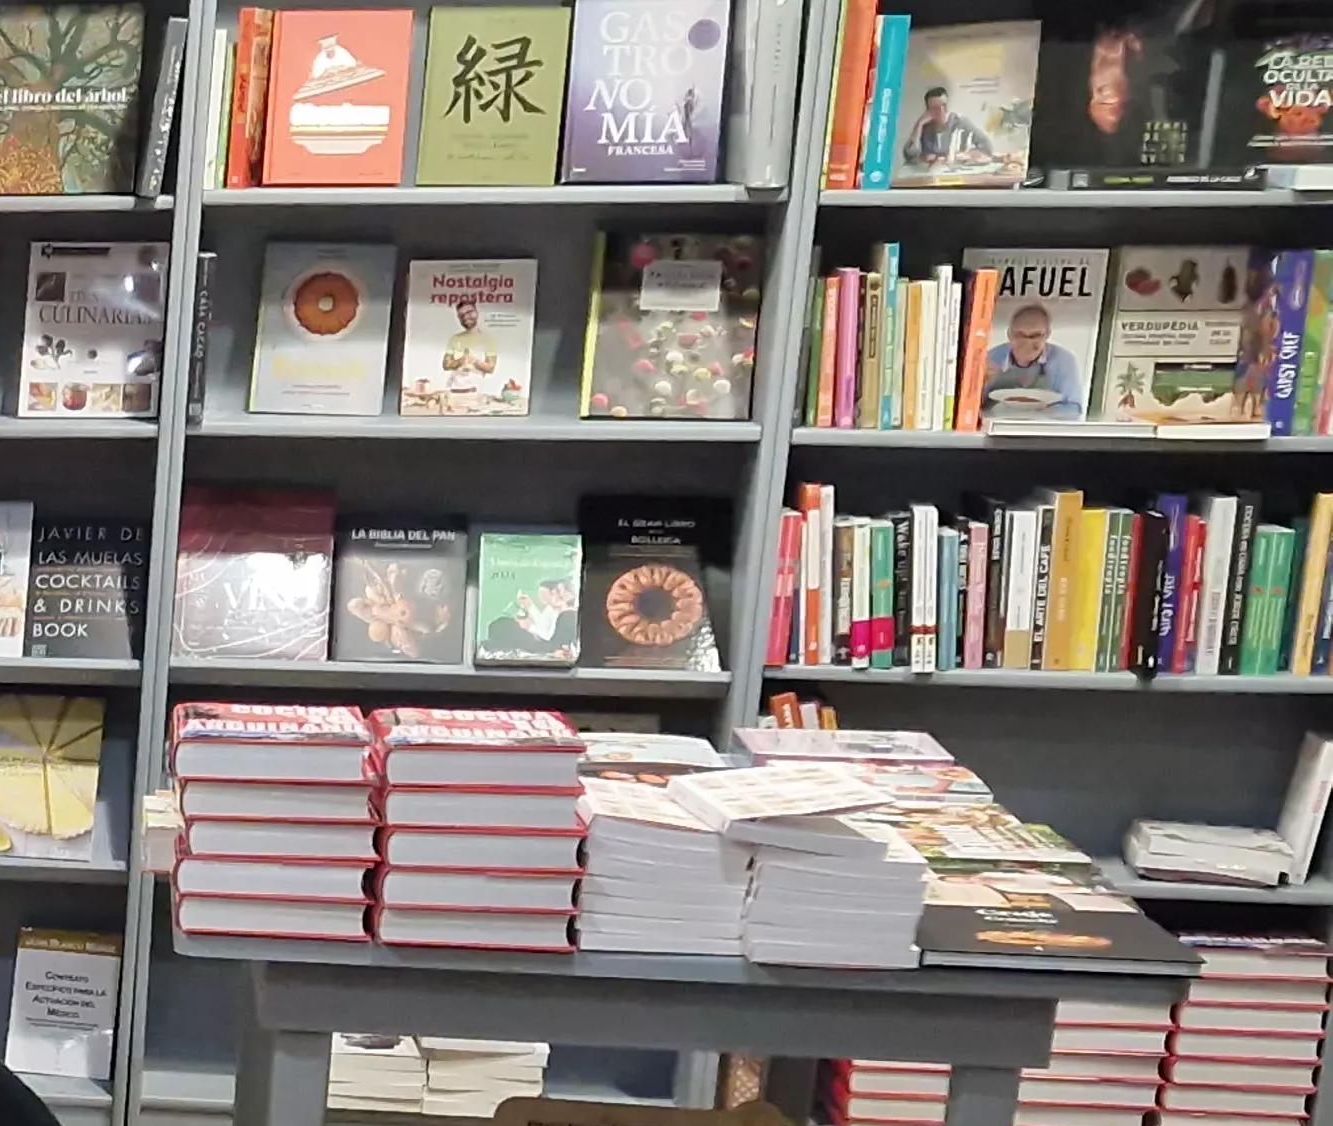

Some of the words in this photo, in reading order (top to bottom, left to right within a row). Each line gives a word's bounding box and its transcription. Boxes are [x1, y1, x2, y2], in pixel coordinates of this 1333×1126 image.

[600, 11, 688, 43] GAS
[603, 45, 693, 75] TRO
[443, 33, 546, 125] 緑
[12, 89, 52, 104] libro
[55, 88, 82, 103] del
[584, 78, 652, 111] NO
[1269, 90, 1333, 108] VIDA
[597, 104, 689, 144] MÍA
[607, 144, 674, 156] FRANCESA
[433, 274, 514, 291] Nostalgia
[431, 291, 514, 305] repostera
[37, 526, 107, 542] JAVIER
[120, 527, 143, 541] DE
[352, 529, 366, 540] LA
[369, 530, 405, 540] BIBLIA
[408, 530, 429, 541] DEL
[433, 531, 455, 541] PAN
[897, 520, 910, 556] Wake
[39, 550, 66, 565] LAS
[74, 552, 143, 566] MUELAS
[35, 573, 140, 589] COCKTAILS
[33, 597, 47, 613] &
[60, 598, 140, 614] DRINKS
[33, 622, 88, 637] BOOK
[231, 705, 350, 716] COCINA
[430, 709, 553, 721] COCINA
